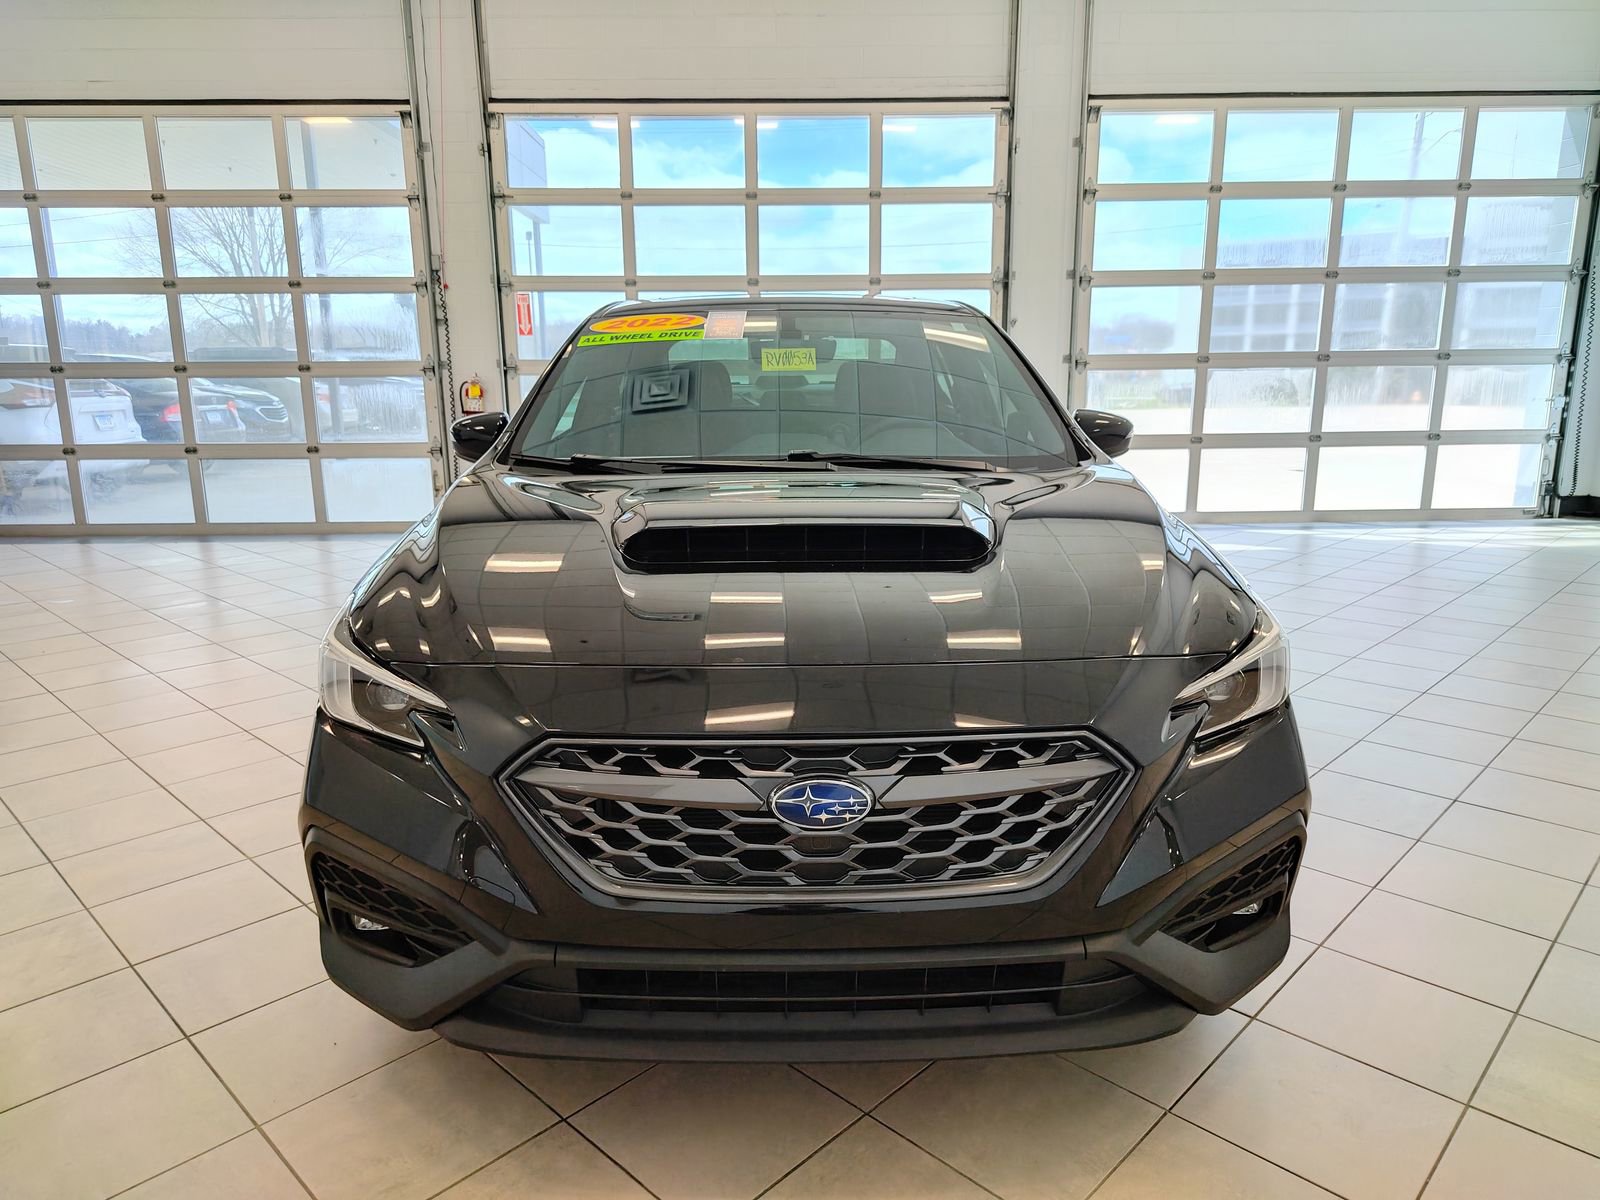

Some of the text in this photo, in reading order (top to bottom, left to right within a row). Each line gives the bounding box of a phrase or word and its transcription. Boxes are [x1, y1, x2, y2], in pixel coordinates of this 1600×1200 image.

[602, 316, 697, 330] 2022
[609, 332, 654, 341] WHEEL
[659, 330, 701, 338] DRIVE
